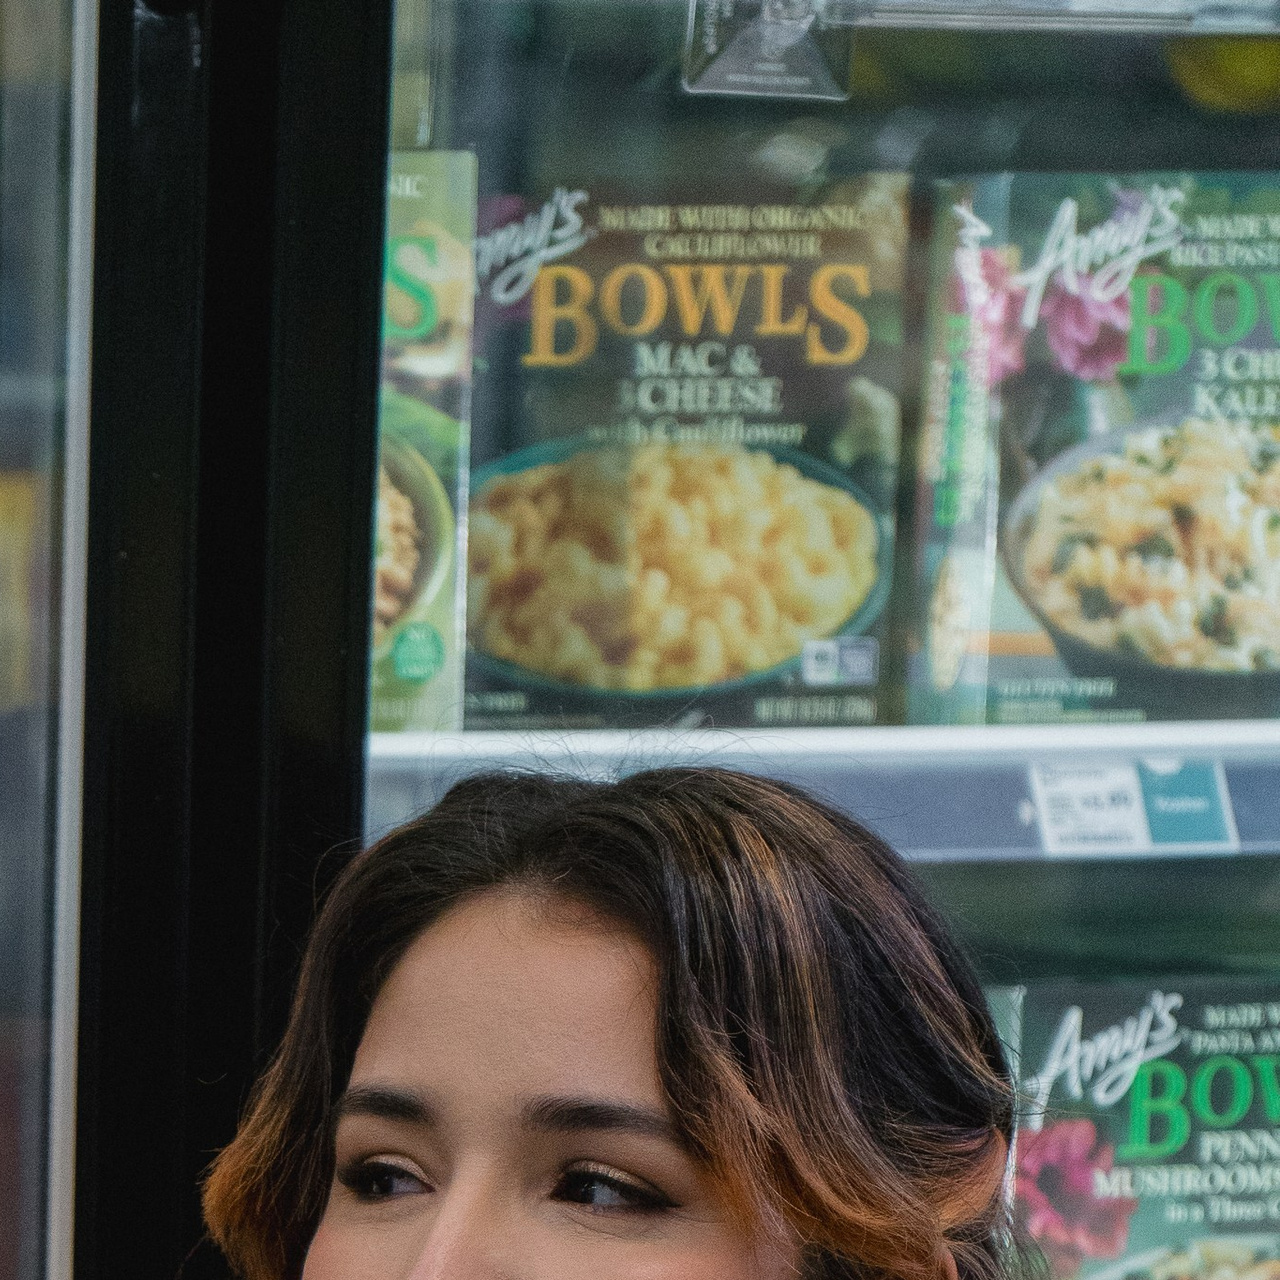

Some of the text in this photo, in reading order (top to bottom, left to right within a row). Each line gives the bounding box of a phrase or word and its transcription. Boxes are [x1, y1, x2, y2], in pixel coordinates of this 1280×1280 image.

[474, 187, 596, 305] my's
[1008, 184, 1186, 329] Amy's
[521, 263, 872, 367] BOWLS
[634, 342, 761, 376] MAC &
[636, 377, 784, 413] CHEESE
[1022, 988, 1184, 1132] Amy's
